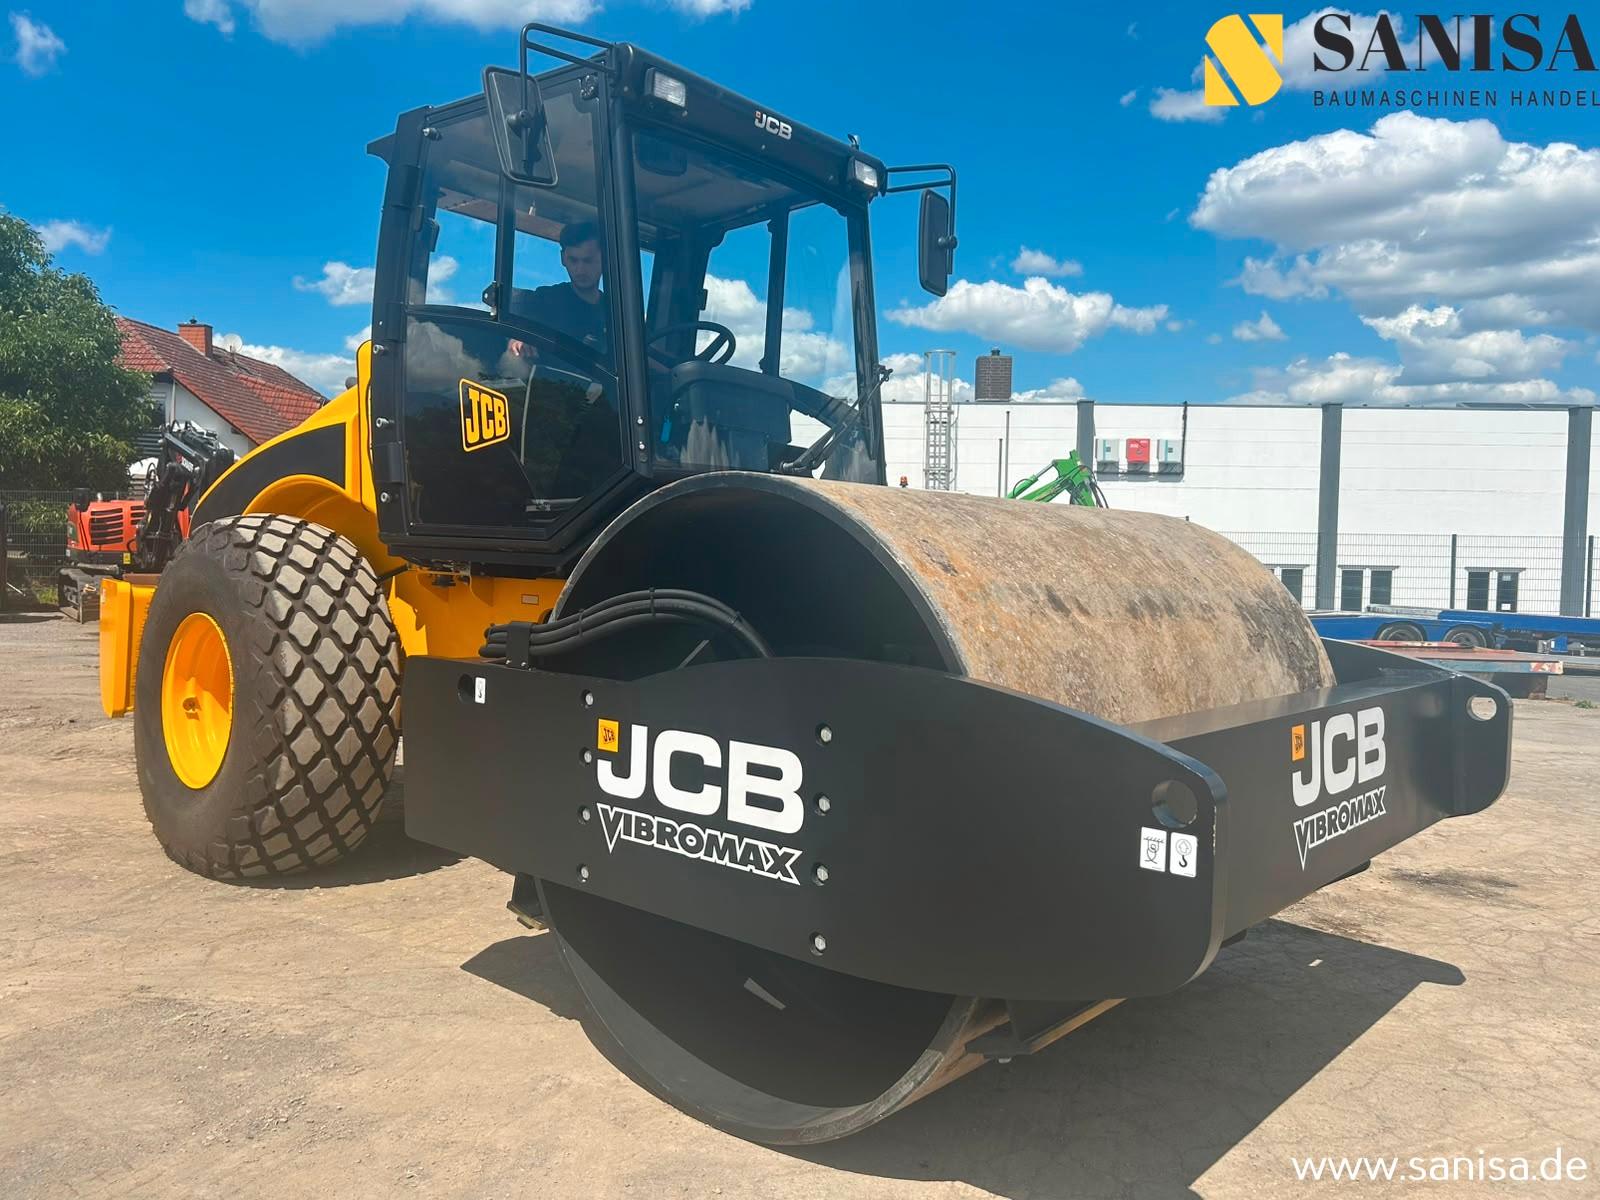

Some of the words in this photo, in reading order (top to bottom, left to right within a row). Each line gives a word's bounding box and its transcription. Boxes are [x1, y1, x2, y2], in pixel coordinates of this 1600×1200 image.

[754, 110, 792, 140] JCB
[465, 387, 507, 444] JCB
[597, 723, 804, 834] JCB
[1292, 706, 1386, 807] JCB
[597, 802, 803, 886] VIBROMAX
[1293, 785, 1386, 871] VIBROMAX
